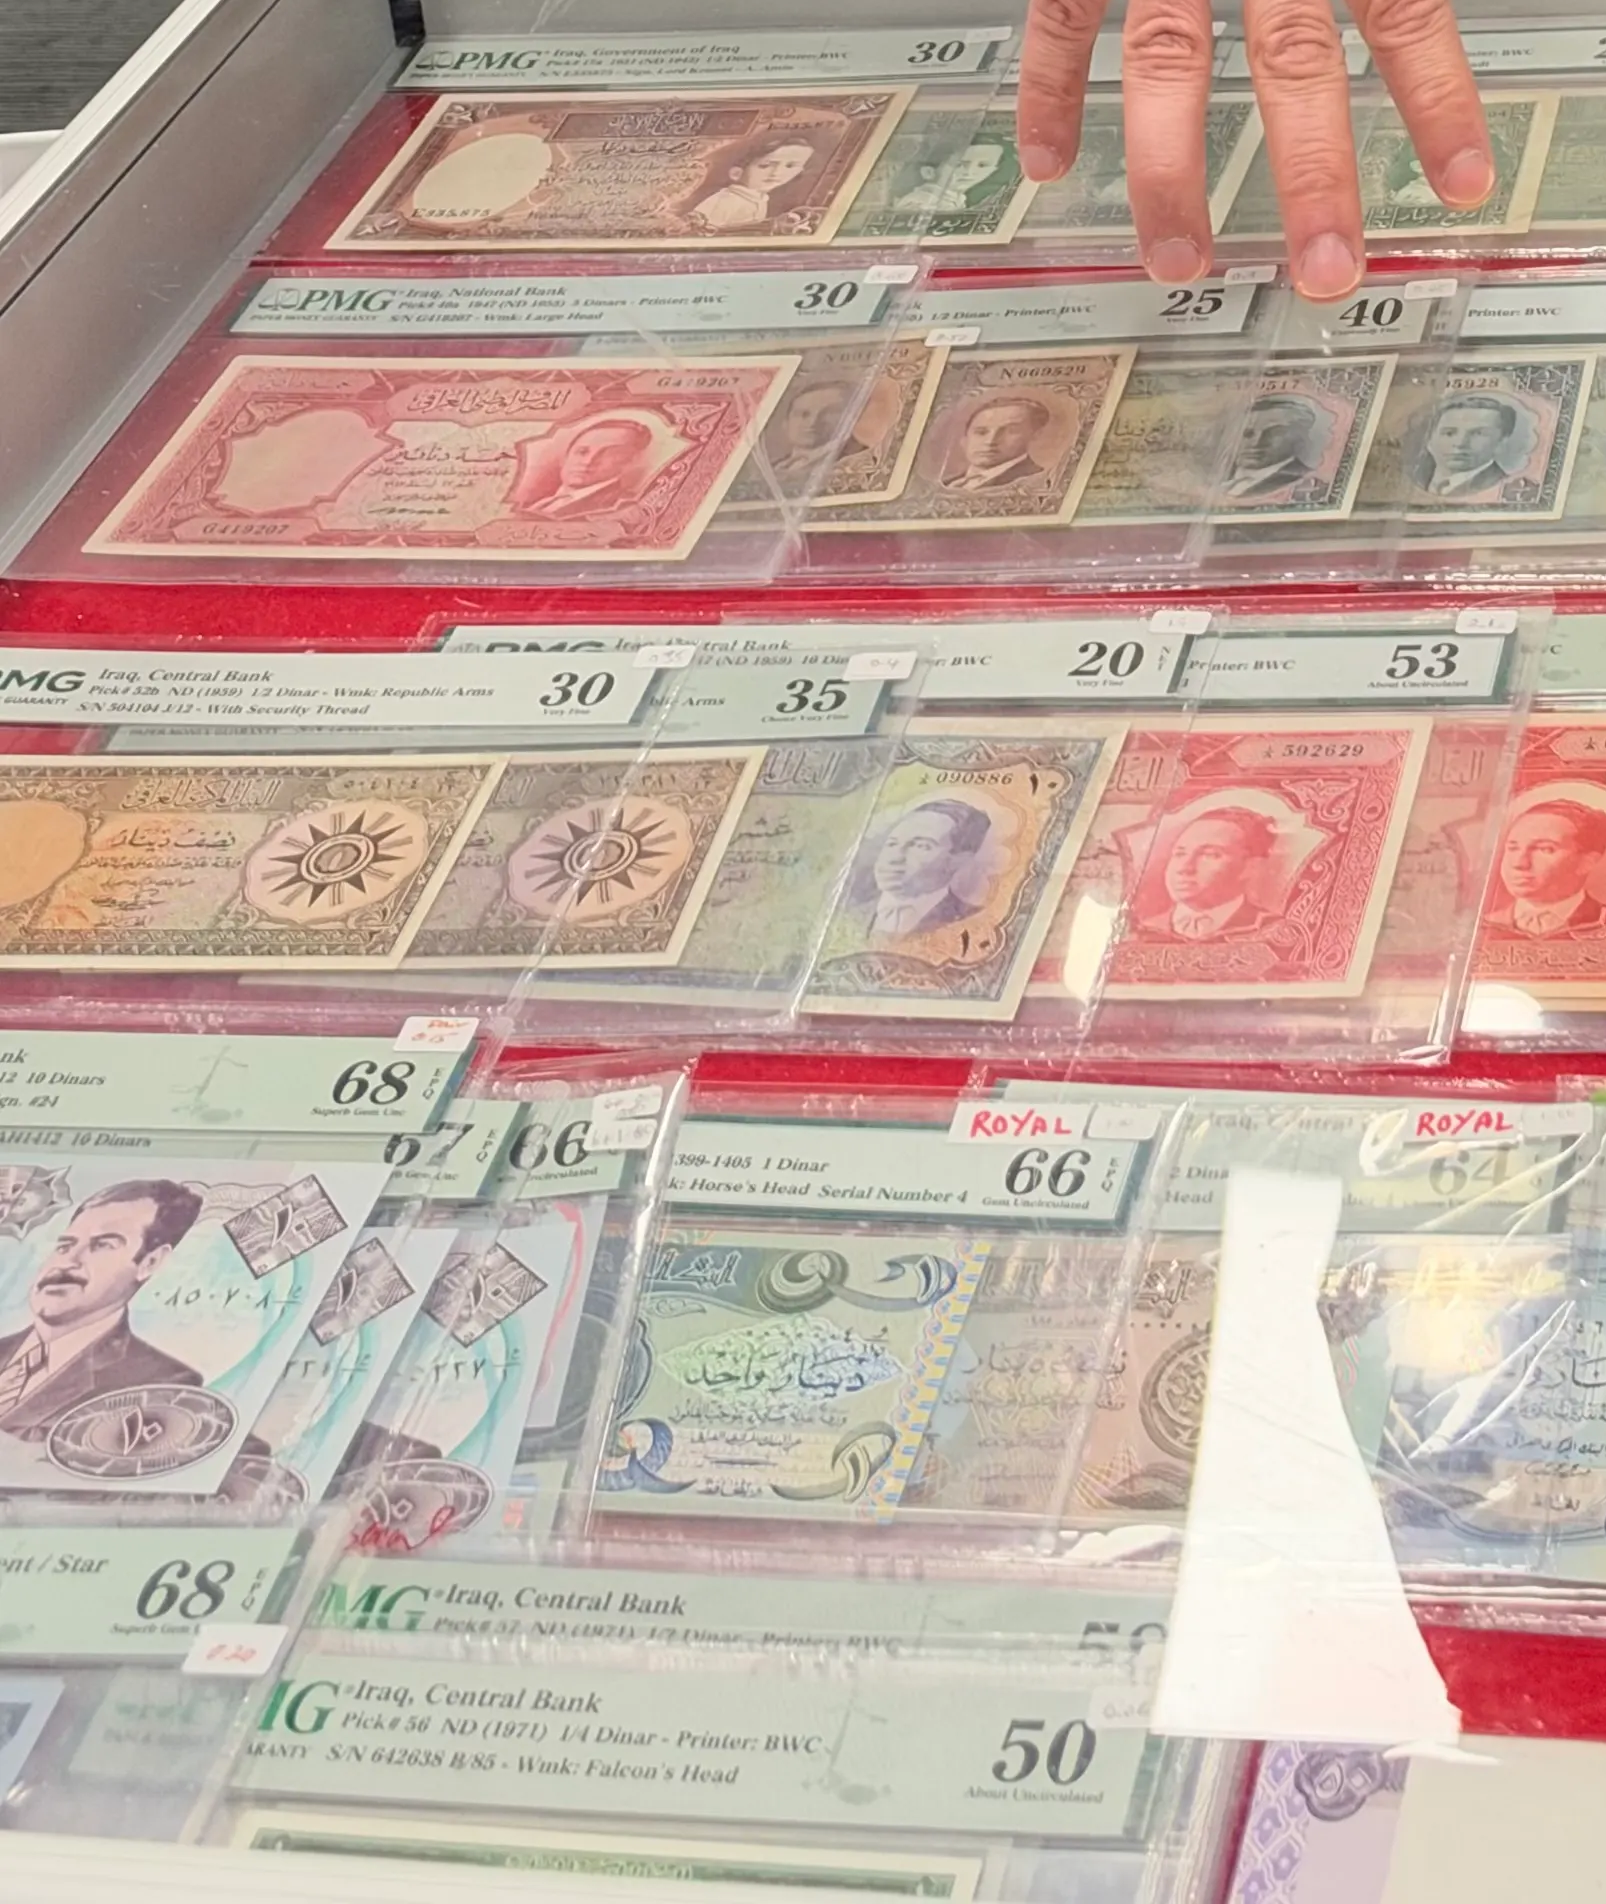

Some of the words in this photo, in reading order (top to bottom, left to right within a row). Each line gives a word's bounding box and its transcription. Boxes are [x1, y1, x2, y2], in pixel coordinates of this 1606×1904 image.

[452, 50, 541, 70] PMG
[906, 40, 966, 64] 30
[297, 288, 393, 313] PMG
[406, 288, 442, 300] Iraq,
[448, 287, 520, 298] National
[524, 286, 567, 296] Bank
[793, 281, 860, 310] 30
[1158, 287, 1226, 317] 25
[1338, 298, 1404, 328] 40
[1467, 306, 1521, 318] Printer:
[1524, 306, 1562, 317] BWC
[741, 640, 792, 652] Bank
[1066, 640, 1145, 677] 20
[1384, 642, 1460, 679] 53
[98, 667, 142, 683] Iraq,
[148, 668, 222, 682] Central
[223, 669, 275, 683] Bank
[950, 655, 992, 667] BWC
[1187, 659, 1252, 673] Printer:
[1252, 658, 1297, 672] BWC
[88, 684, 131, 696] Pick#
[168, 685, 195, 697] ND
[275, 686, 320, 698] Dinar
[332, 686, 378, 698] Wmk:
[381, 686, 448, 699] Republic
[451, 687, 495, 698] Arms
[538, 671, 615, 707] 30
[775, 677, 851, 714] 35
[207, 703, 244, 714] With
[246, 703, 311, 718] Security
[315, 704, 370, 715] Thread
[935, 771, 1014, 786] 090886
[26, 1072, 45, 1085] 10
[48, 1072, 106, 1087] Dinars
[331, 1059, 417, 1106] 68
[969, 1108, 1073, 1139] ROYAL
[1415, 1109, 1514, 1138] ROYAL
[95, 1134, 151, 1150] Dinars
[508, 1119, 590, 1170] 66
[775, 1157, 829, 1174] Dinar
[1005, 1146, 1092, 1198] 66
[688, 1176, 758, 1196] Horse's
[763, 1181, 811, 1197] Head
[818, 1184, 873, 1201] Serial
[879, 1186, 952, 1204] Number
[956, 1188, 967, 1204] 4
[52, 1552, 109, 1575] Star
[135, 1559, 236, 1620] 68
[443, 1581, 506, 1612] Iraq,
[513, 1585, 613, 1614] Central
[616, 1592, 687, 1616] Bank
[351, 1679, 416, 1710] Iraq,
[425, 1682, 527, 1711] Central
[532, 1688, 602, 1713] Bank
[341, 1710, 400, 1733] Pick#
[404, 1713, 431, 1733] 56
[440, 1715, 478, 1736] ND
[480, 1716, 547, 1742] (1971)
[559, 1724, 588, 1743] 1/4
[593, 1725, 658, 1748] Dinar
[676, 1729, 759, 1753] Printer:
[764, 1733, 823, 1755] BWC
[325, 1742, 368, 1762] S/N
[371, 1746, 444, 1767] 642638
[516, 1754, 581, 1776] Wmk:
[586, 1758, 675, 1782] Falcon's
[680, 1763, 740, 1785] Head
[990, 1717, 1098, 1787] 50
